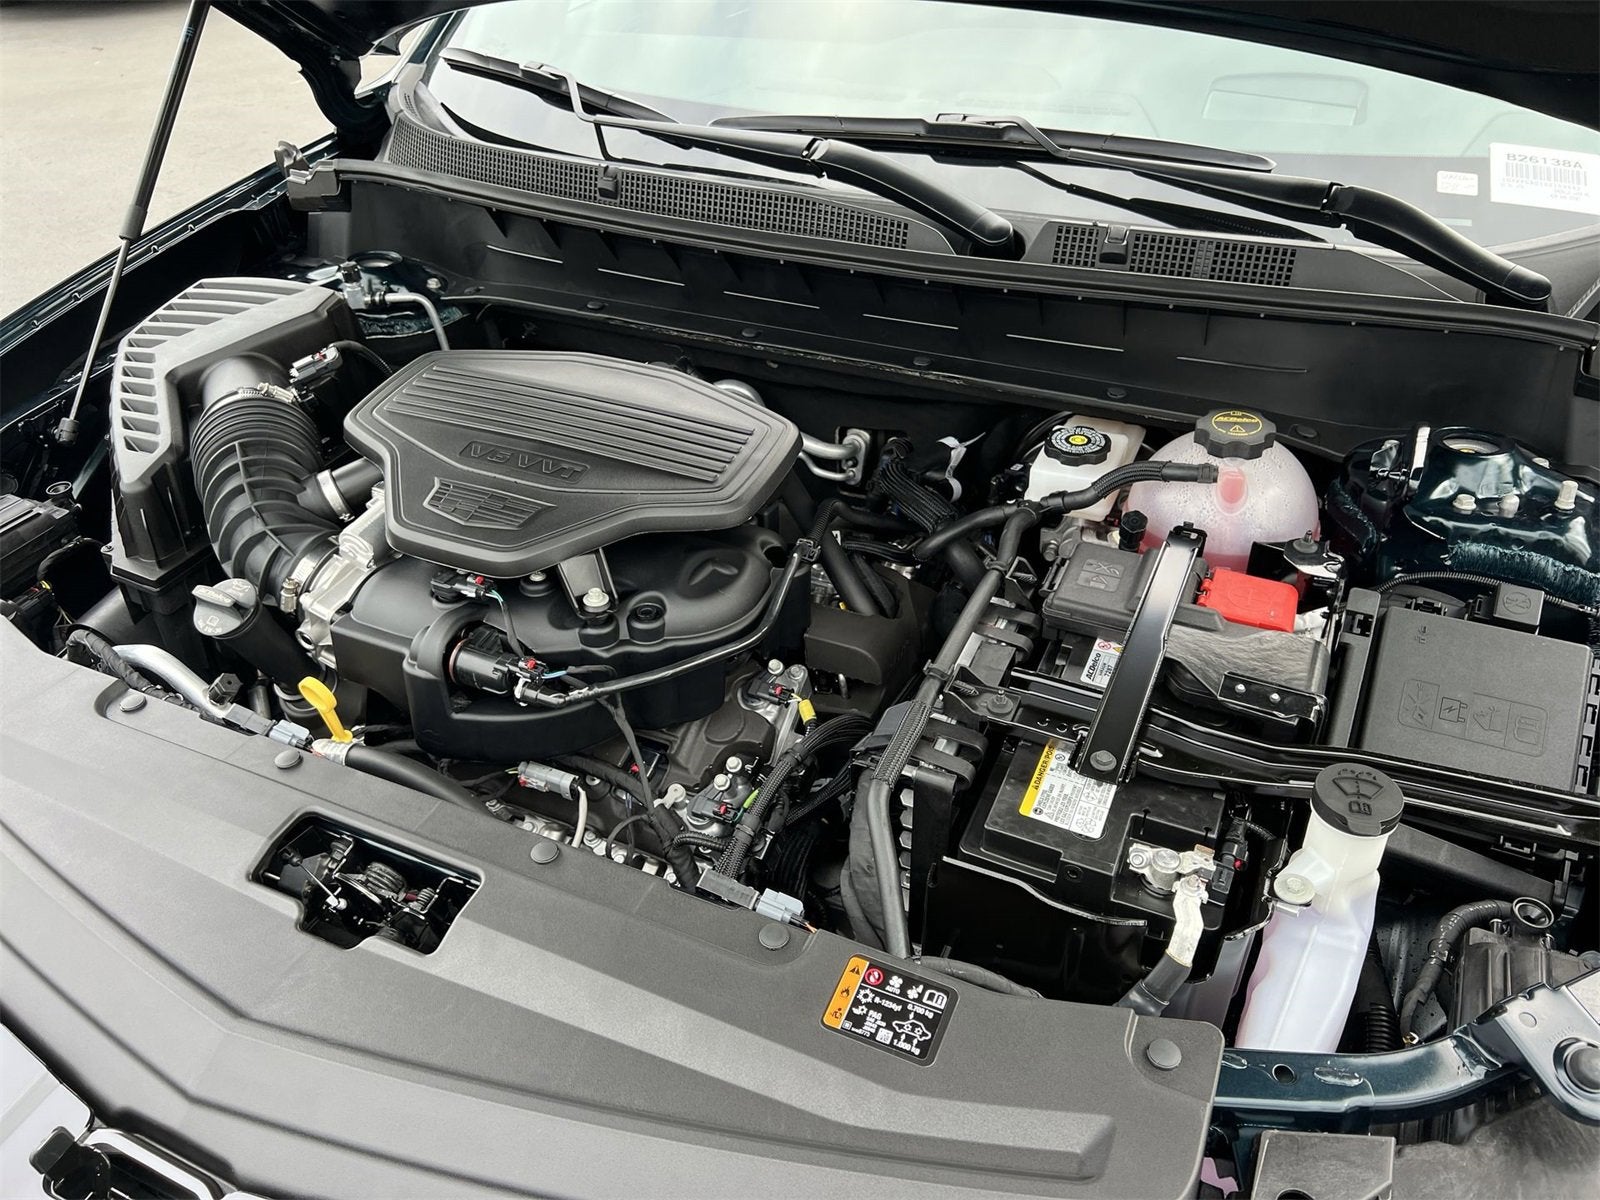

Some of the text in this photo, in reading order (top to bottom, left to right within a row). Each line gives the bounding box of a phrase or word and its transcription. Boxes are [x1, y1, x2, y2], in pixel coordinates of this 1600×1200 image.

[1506, 153, 1583, 169] B26138A
[518, 453, 583, 479] VVT
[1086, 653, 1101, 680] ACDelco
[885, 985, 900, 994] AUTO
[874, 996, 902, 1012] R-1234yf
[868, 1010, 882, 1020] PAG
[925, 1009, 934, 1019] kg
[911, 1046, 920, 1055] kg
